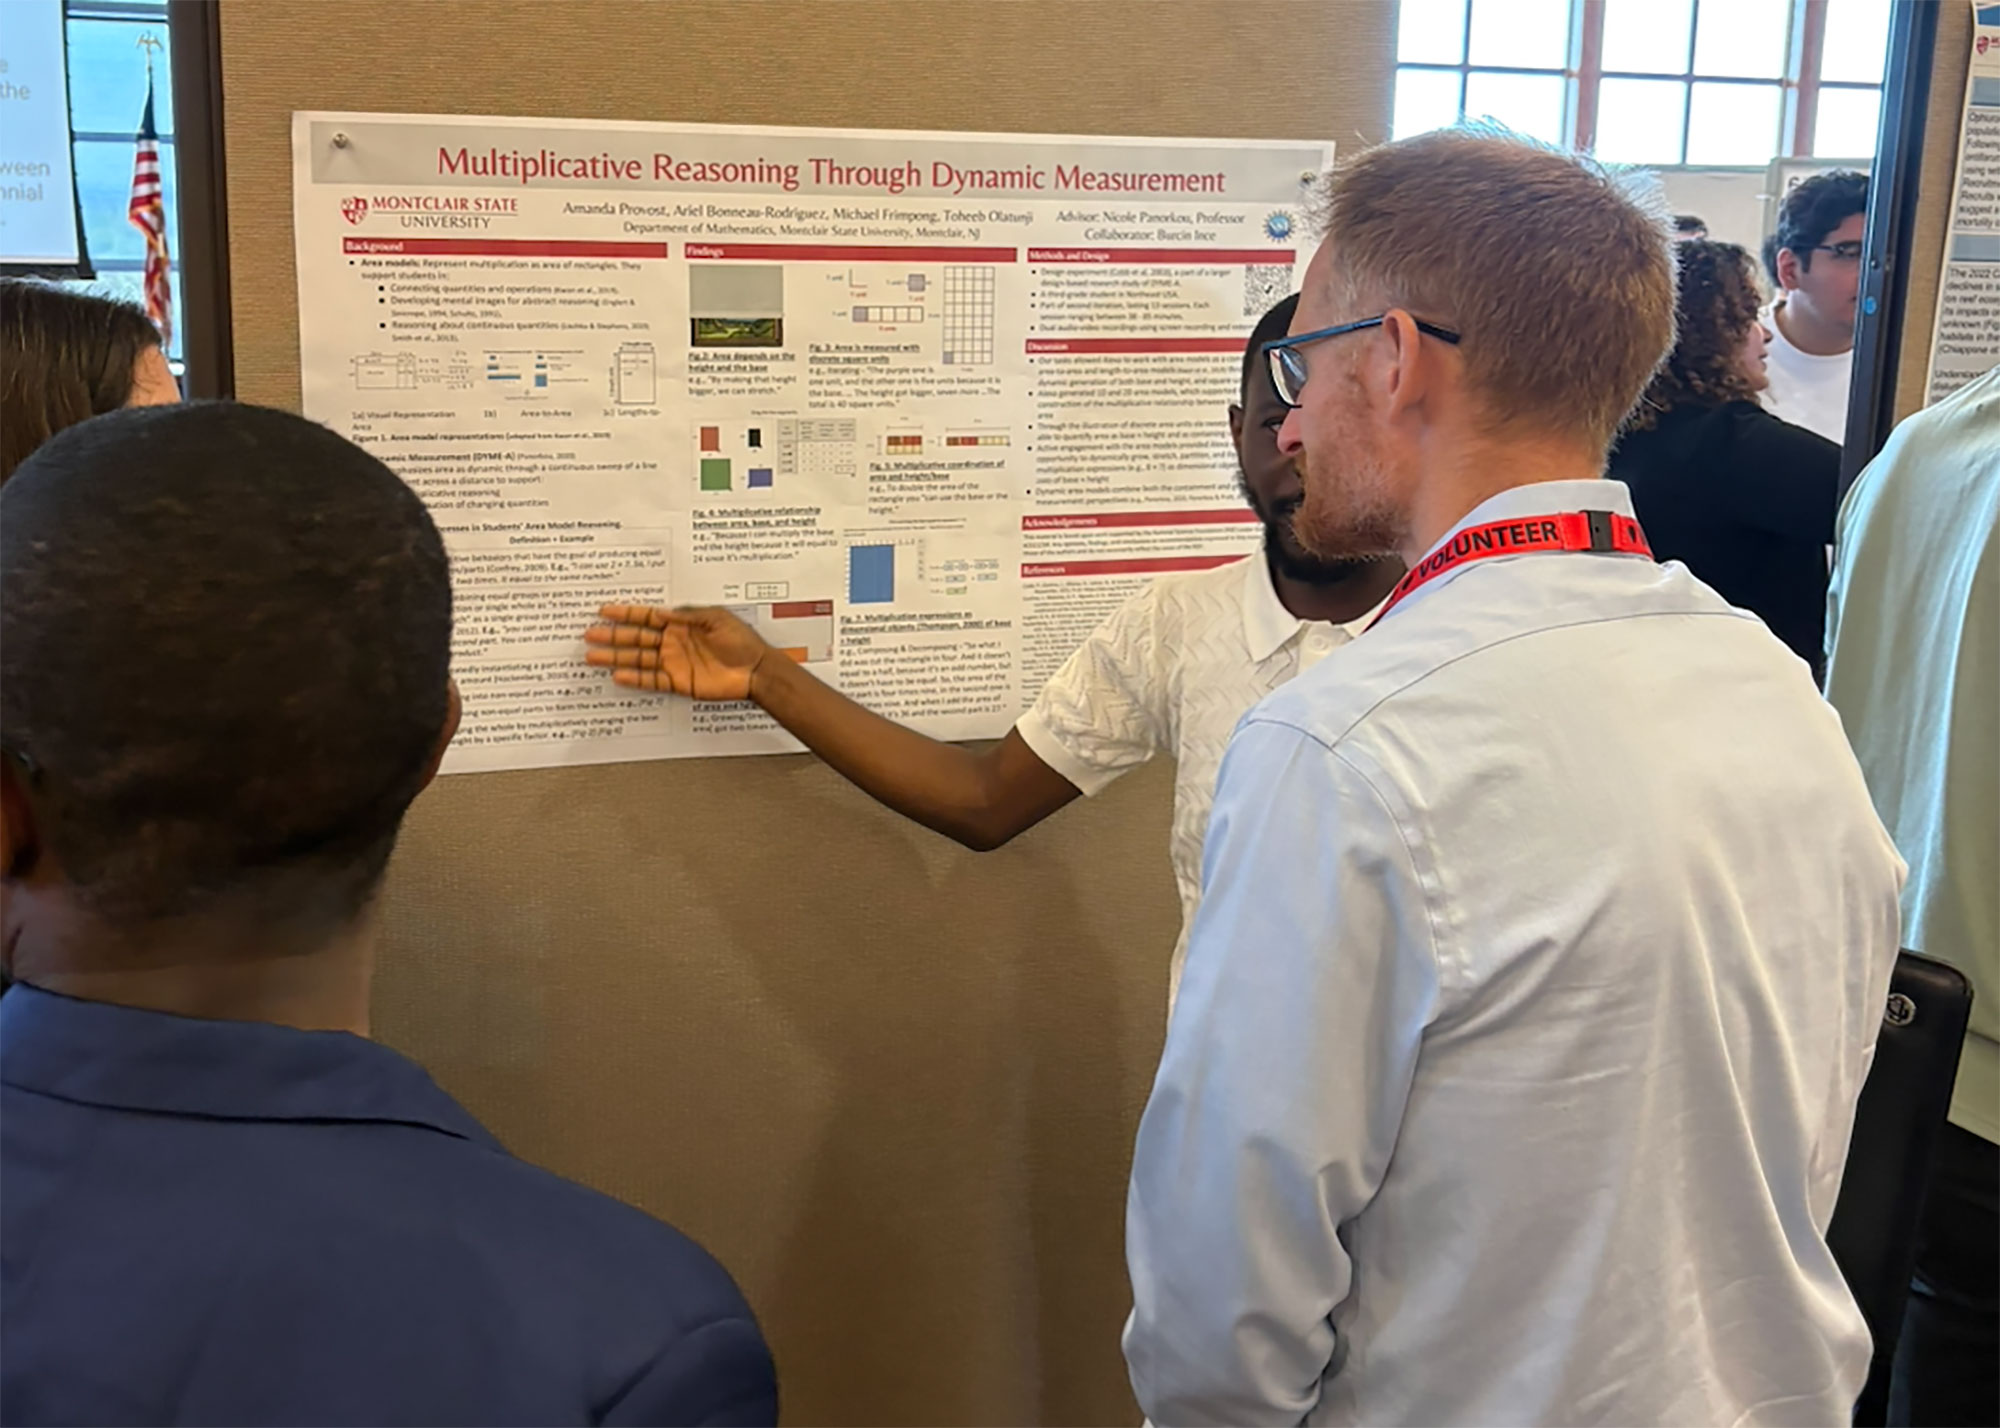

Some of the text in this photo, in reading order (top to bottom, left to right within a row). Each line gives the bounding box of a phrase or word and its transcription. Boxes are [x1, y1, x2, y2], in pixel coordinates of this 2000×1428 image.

[437, 146, 1226, 196] Multiplicative Reasoning Through Dynamic Measurement
[372, 195, 519, 216] MONTCLAIR STATE
[562, 201, 1033, 225] Amanda Provost, Ariel Bonneau-Rodriguez, Michael Frimpong, Toheeb Olatunji
[1055, 210, 1244, 224] Advisor: Nicole Panorkou, Professor
[400, 215, 490, 228] UNIVERSITY
[622, 221, 980, 241] Department of Mathematics, Montclair State University, Montclair, NJ
[1084, 227, 1216, 241] Collaborator: Burcin Ince
[345, 241, 404, 254] Background
[686, 246, 724, 259] Findings
[1028, 250, 1109, 263] Methods and Design
[1026, 341, 1068, 353] Discussion
[1418, 521, 1560, 579] VOLUNTEER
[1022, 564, 1065, 577] References
